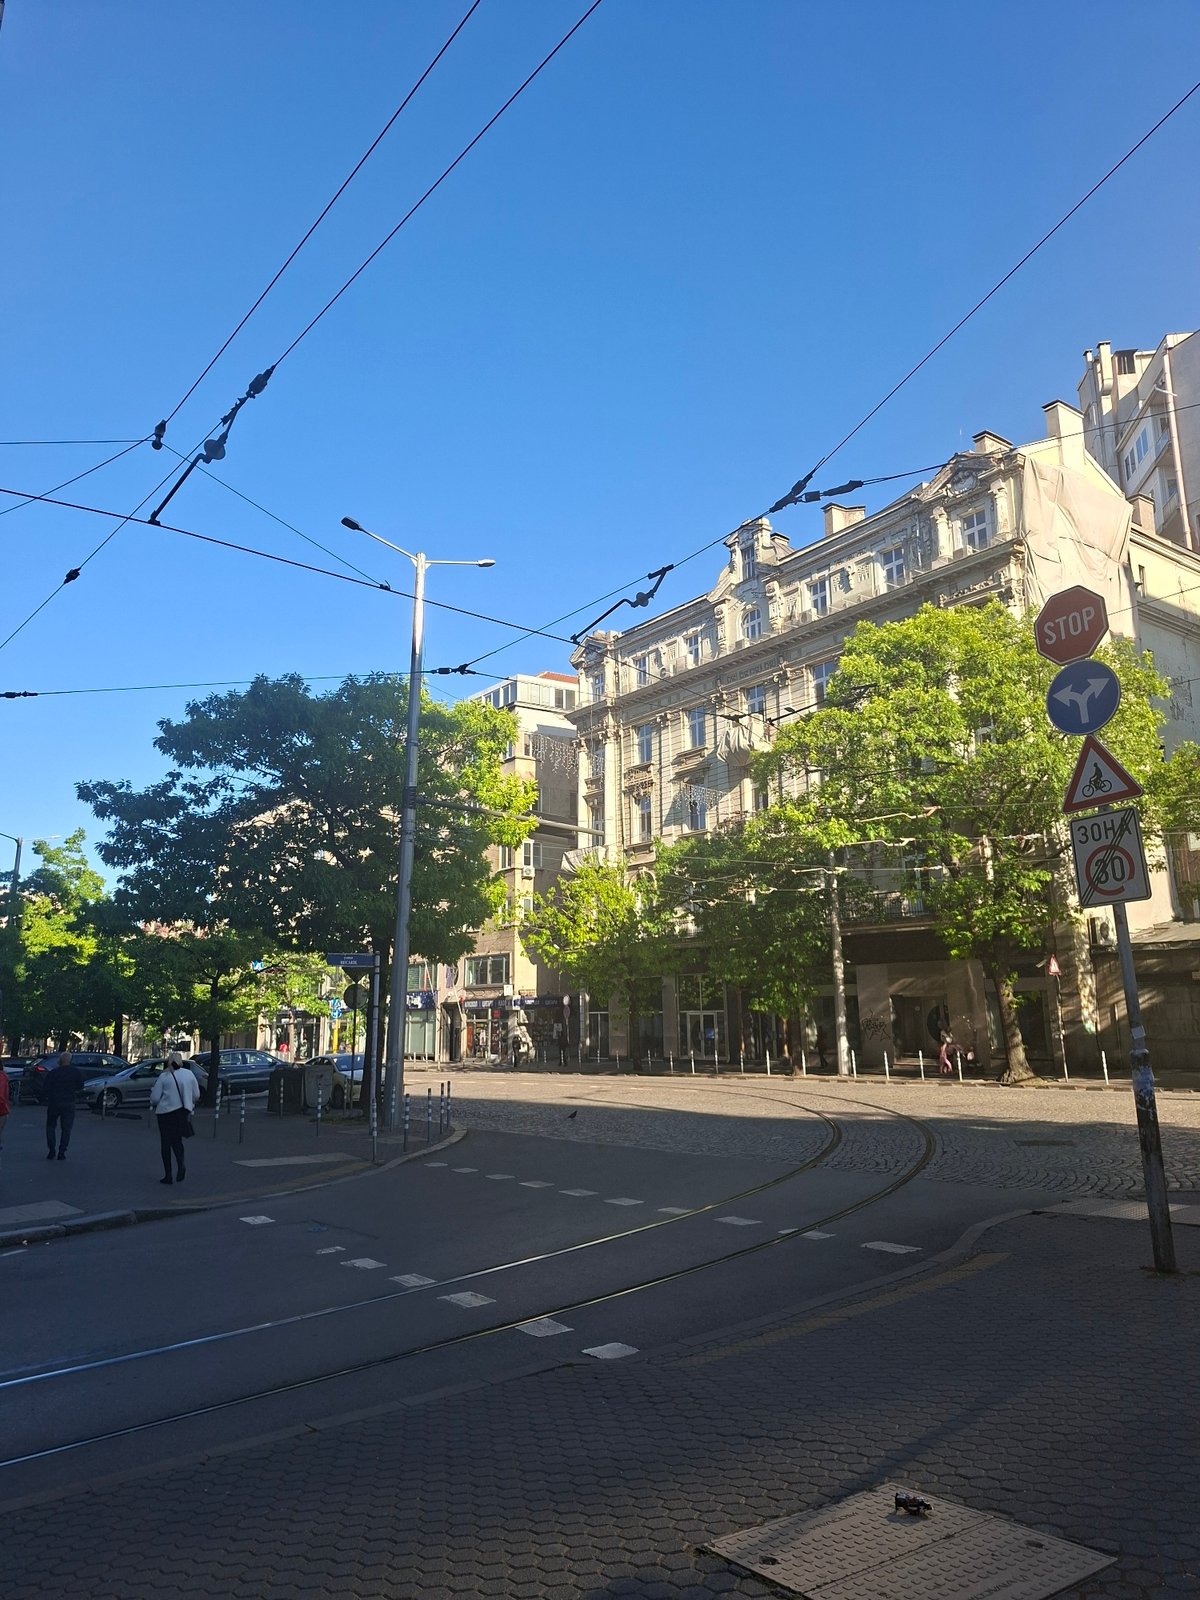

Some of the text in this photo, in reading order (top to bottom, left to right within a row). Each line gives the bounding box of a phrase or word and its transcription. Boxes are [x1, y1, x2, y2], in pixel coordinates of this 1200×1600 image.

[1043, 606, 1095, 645] STOP
[1077, 817, 1132, 844] ЗОНА
[1095, 856, 1125, 884] 30
